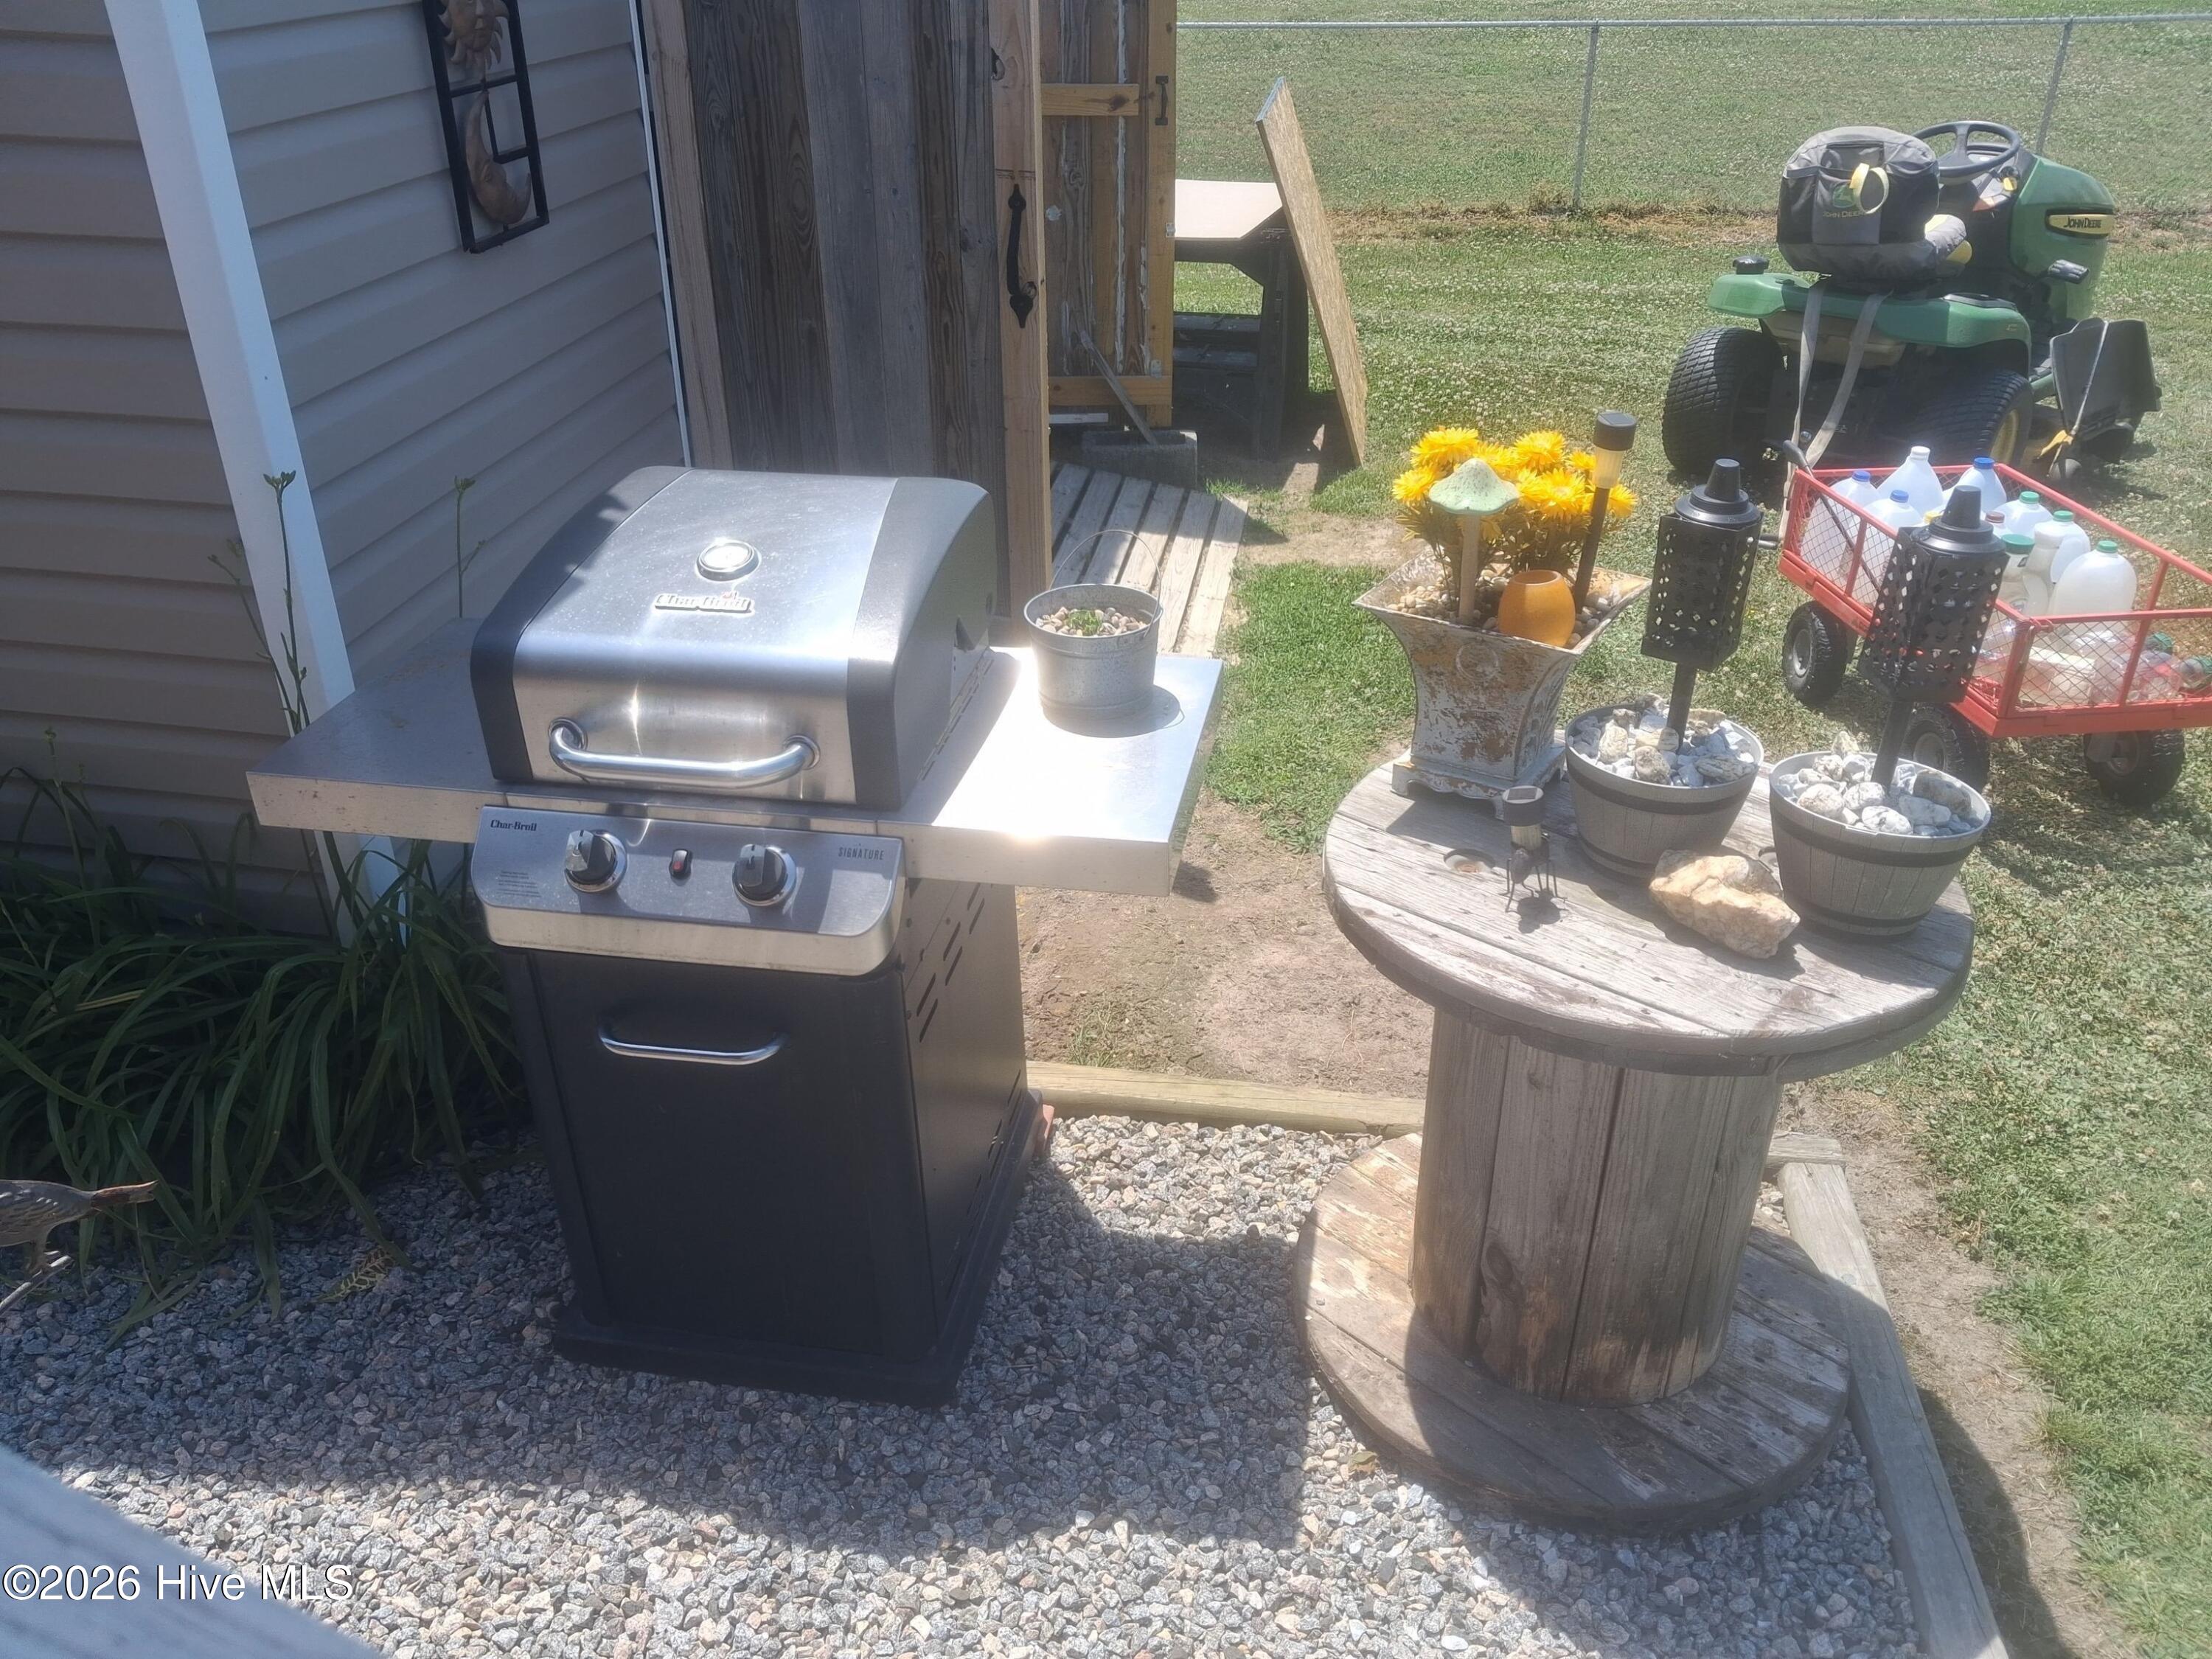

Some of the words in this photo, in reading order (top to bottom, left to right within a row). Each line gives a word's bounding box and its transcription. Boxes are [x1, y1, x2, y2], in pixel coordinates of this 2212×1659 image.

[2063, 216, 2084, 229] JOHN
[2084, 217, 2101, 229] DEERE
[490, 819, 537, 832] Char-Broil
[838, 846, 885, 860] SIGNATURE
